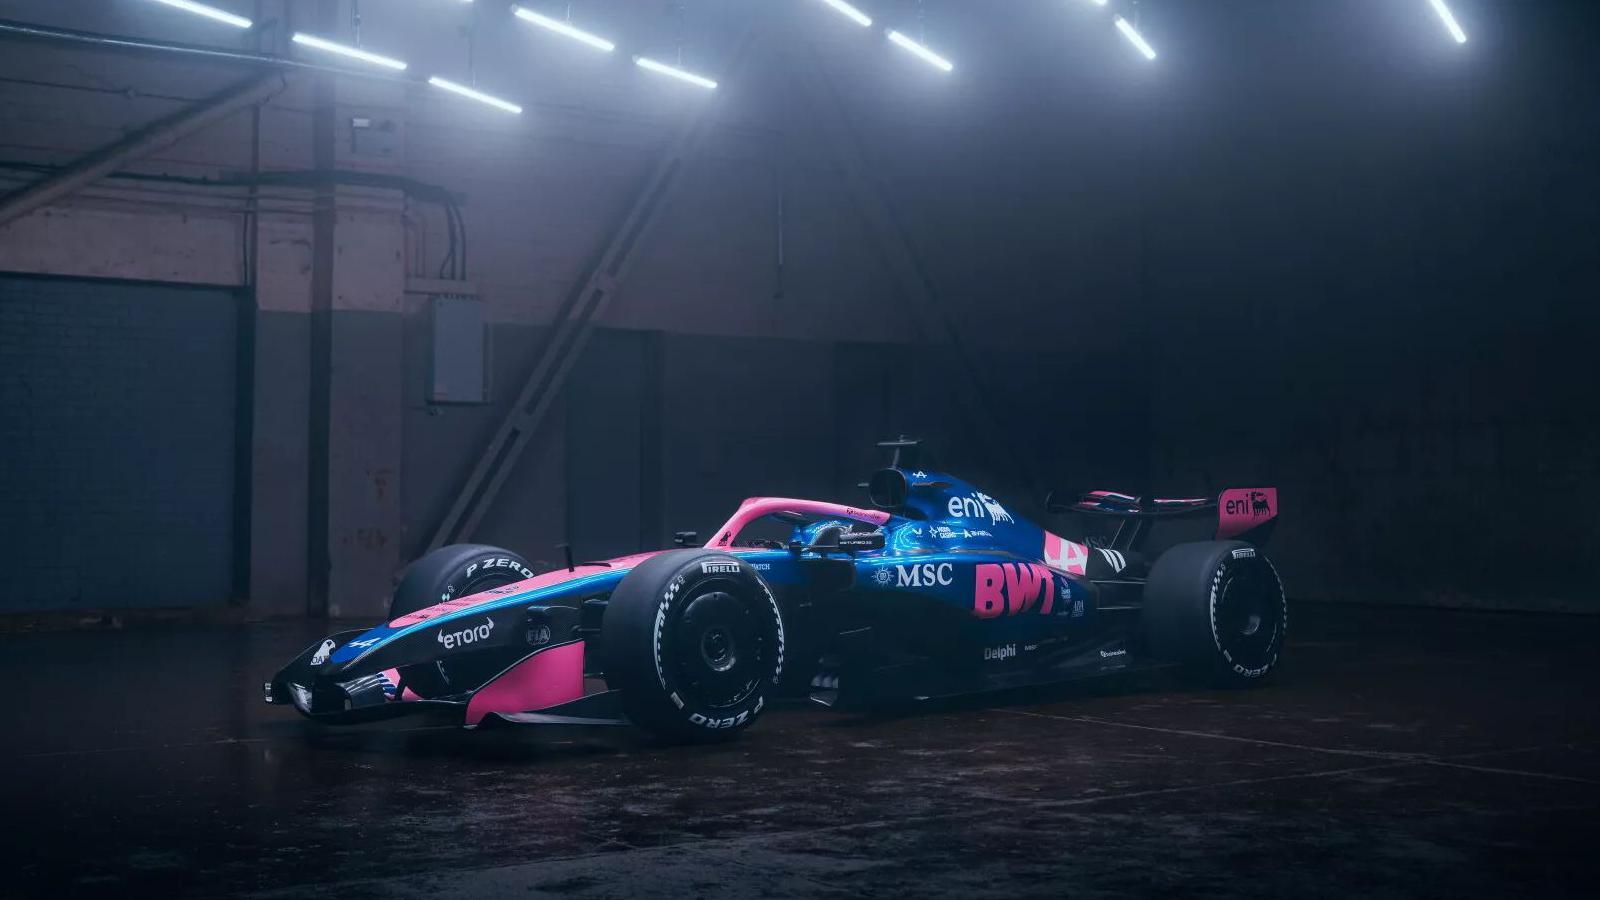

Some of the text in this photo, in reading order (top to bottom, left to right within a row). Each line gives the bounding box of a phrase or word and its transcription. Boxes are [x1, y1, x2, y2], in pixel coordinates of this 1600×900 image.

[947, 493, 984, 518] eni
[1226, 494, 1249, 515] eni
[1231, 548, 1256, 559] PIRELLI
[466, 558, 535, 578] P ZERO
[701, 562, 740, 574] PIRELLI
[895, 563, 953, 588] MSC
[974, 563, 1055, 619] BWT
[984, 643, 1016, 660] Delphi
[1233, 663, 1269, 677] ZERO
[689, 696, 764, 729] P ZERO
